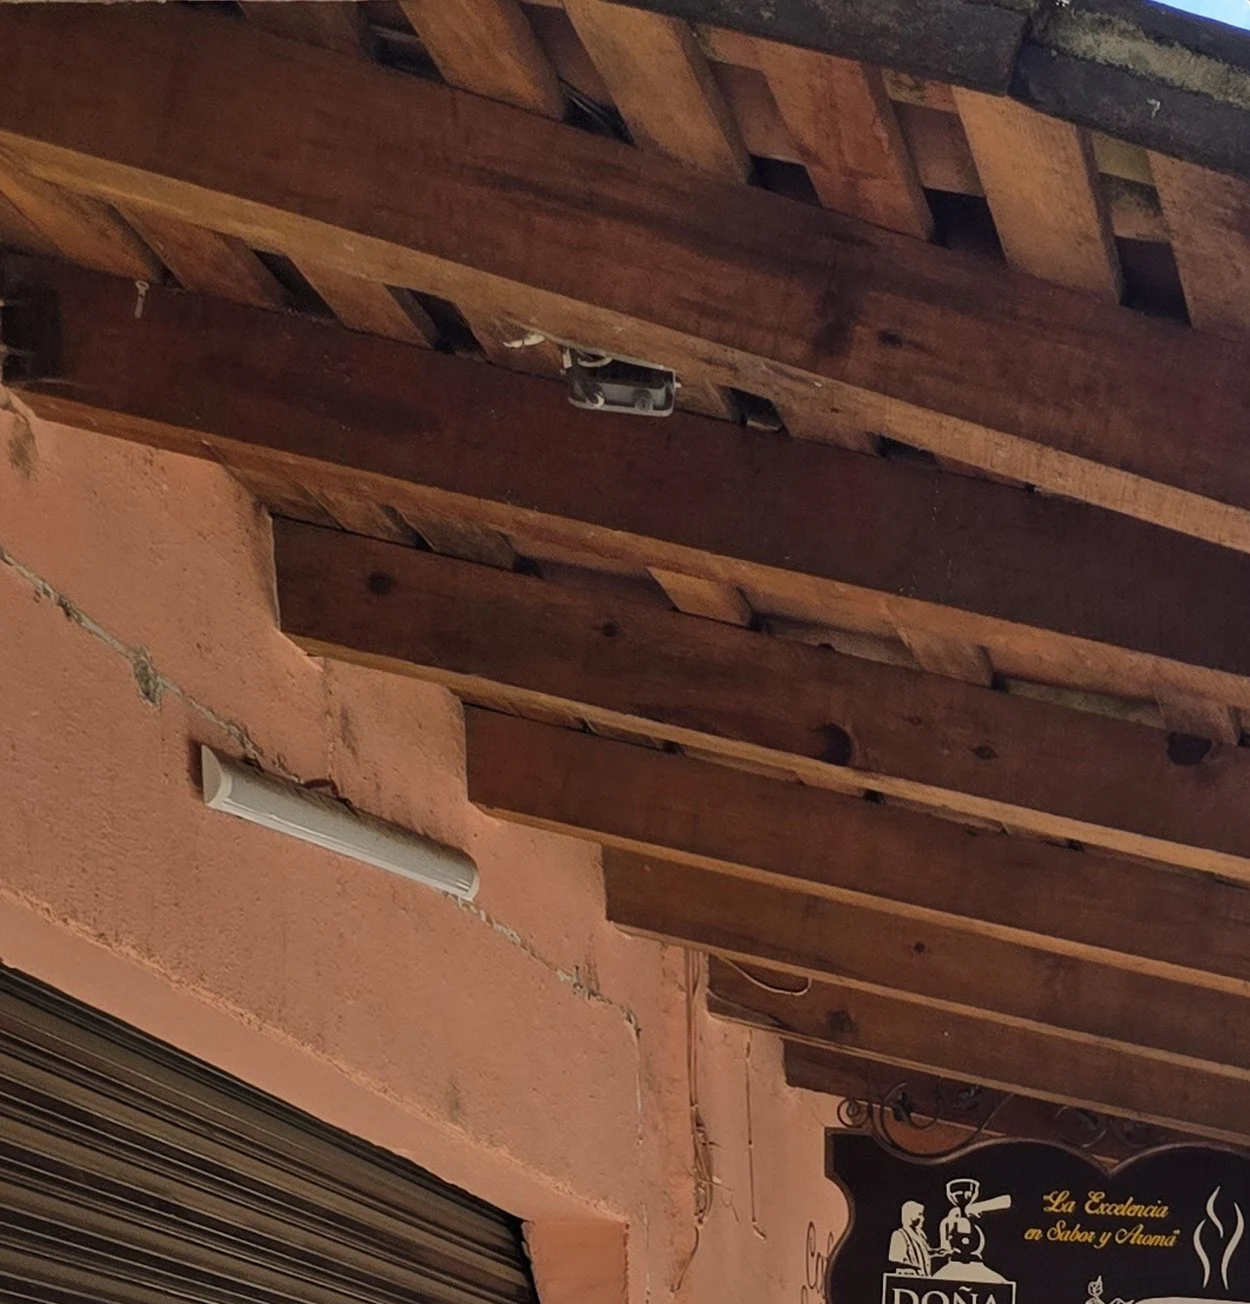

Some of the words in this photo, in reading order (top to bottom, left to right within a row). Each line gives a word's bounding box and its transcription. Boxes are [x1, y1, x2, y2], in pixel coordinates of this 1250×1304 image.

[1084, 1190, 1169, 1218] Excelencia
[1024, 1227, 1043, 1241] en
[1047, 1219, 1096, 1243] Sabor
[1093, 1231, 1112, 1249] y
